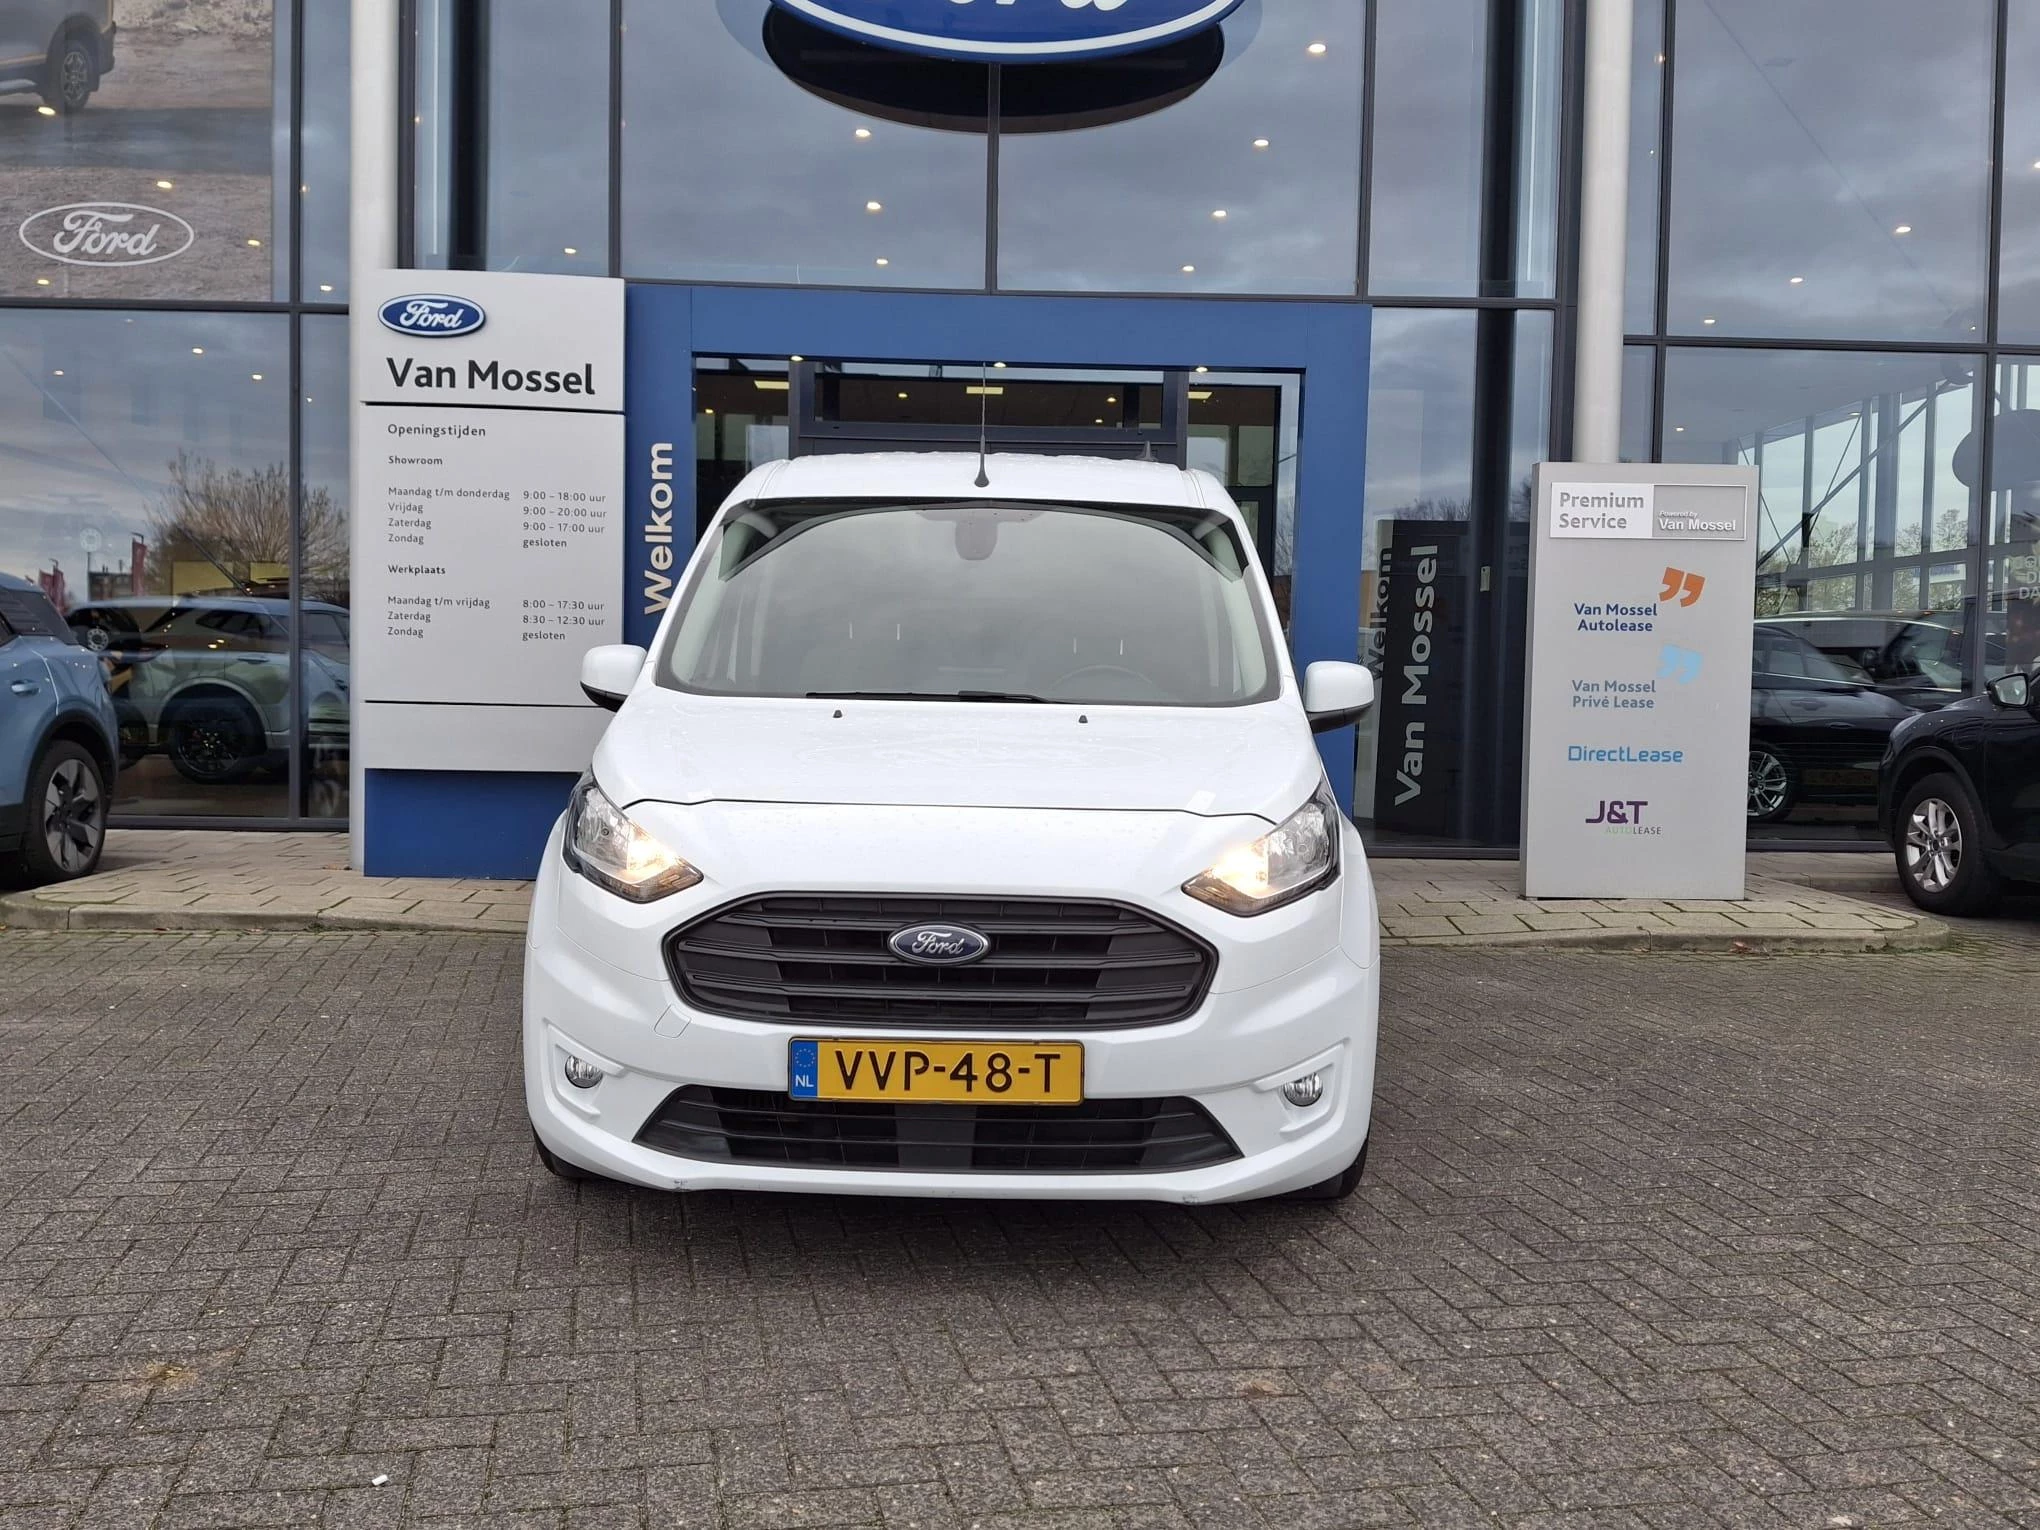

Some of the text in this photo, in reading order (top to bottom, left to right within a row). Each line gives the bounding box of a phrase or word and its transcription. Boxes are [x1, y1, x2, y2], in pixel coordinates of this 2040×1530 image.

[53, 210, 160, 256] Ford
[400, 300, 463, 329] Ford
[386, 357, 596, 396] Van Mossel
[387, 423, 486, 439] Openingstijden
[388, 455, 443, 465] Showroom
[388, 487, 510, 501] Maandag t/m donderdag
[523, 490, 546, 500] 9:00
[557, 491, 587, 502] 18:00
[1559, 491, 1645, 510] Premium
[387, 502, 424, 515] Vrijdag
[523, 506, 546, 516] 9:00
[557, 507, 587, 517] 20:00
[388, 517, 432, 530] Zaterdag
[522, 521, 546, 532] 9:00
[557, 522, 585, 533] 17:00
[588, 526, 605, 534] uur
[644, 443, 674, 614] Welkom
[1558, 513, 1628, 530] Service
[1659, 518, 1737, 532] Van Mossel
[388, 533, 425, 546] Zondag
[522, 537, 568, 549] gesloten
[387, 564, 446, 577] Werkplaats
[387, 595, 491, 610] Maandag t/m vrijdag
[522, 599, 546, 609] 8:00
[557, 600, 585, 610] 17:30
[587, 603, 605, 611] uur
[1573, 602, 1658, 617] Van Mossel
[387, 610, 431, 624] Zaterdag
[522, 614, 546, 624] 8:30
[557, 615, 586, 625] 12:30
[588, 618, 605, 626] uur
[1577, 618, 1653, 632] Autolease
[387, 626, 424, 639] Zondag
[522, 630, 566, 642] gesloten
[1395, 545, 1438, 806] Van Mossel
[1571, 679, 1657, 693] Van Mossel
[1613, 695, 1655, 709] Lease
[1567, 745, 1684, 763] DirectLease
[1584, 800, 1649, 825] J&T
[911, 930, 965, 954] Ford
[834, 1050, 1062, 1094] VVP-48-T
[795, 1074, 814, 1088] NL
